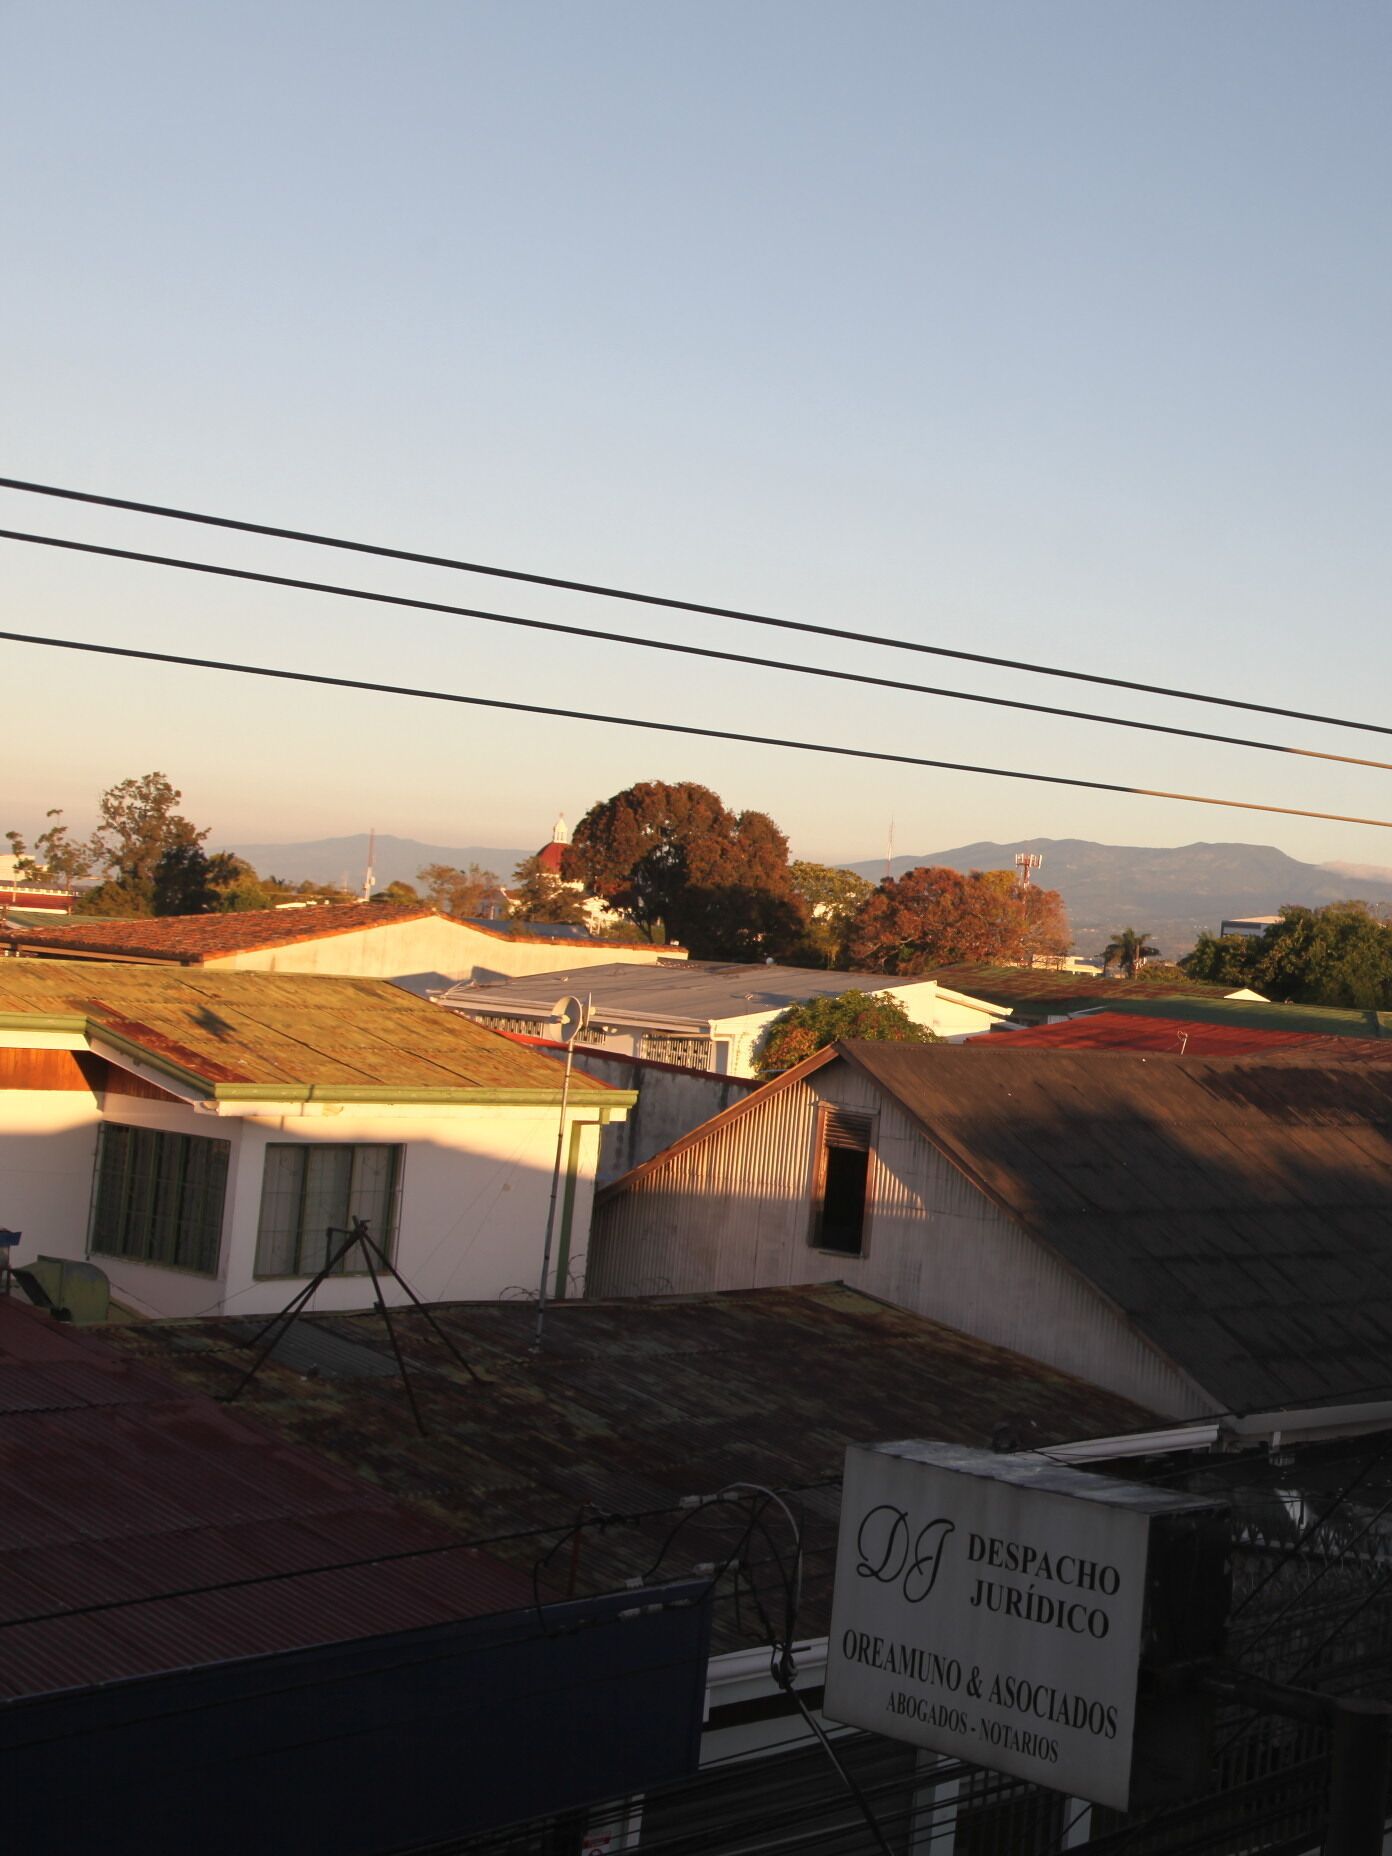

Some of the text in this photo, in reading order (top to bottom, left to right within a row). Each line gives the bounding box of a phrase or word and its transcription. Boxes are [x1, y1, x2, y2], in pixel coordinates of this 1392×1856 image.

[967, 1532, 1121, 1597] DESPACHO
[970, 1578, 1110, 1640] JURÍDICO
[842, 1628, 1119, 1740] OREAMUNO & ASOCIADOS
[886, 1691, 968, 1735] ABOGADOS
[979, 1717, 1059, 1765] NOTARIOS
